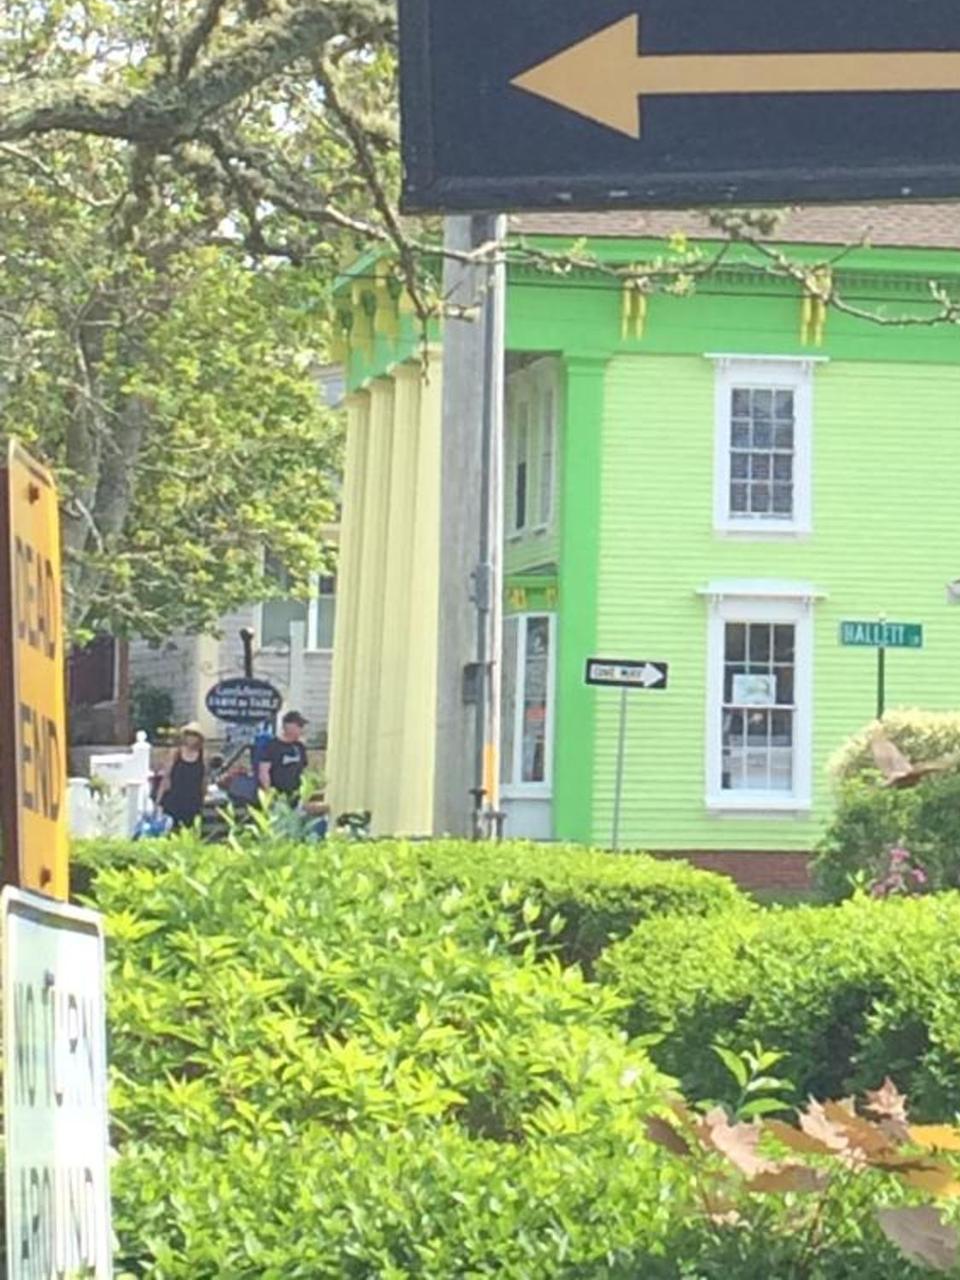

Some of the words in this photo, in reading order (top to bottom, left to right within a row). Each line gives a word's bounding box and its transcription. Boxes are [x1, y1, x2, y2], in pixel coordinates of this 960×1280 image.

[15, 535, 57, 661] DEAD
[844, 623, 904, 645] HALLETT
[19, 701, 61, 823] END
[13, 982, 35, 1107] NO
[41, 986, 97, 1108] TURN
[10, 1165, 97, 1280] AROUND
